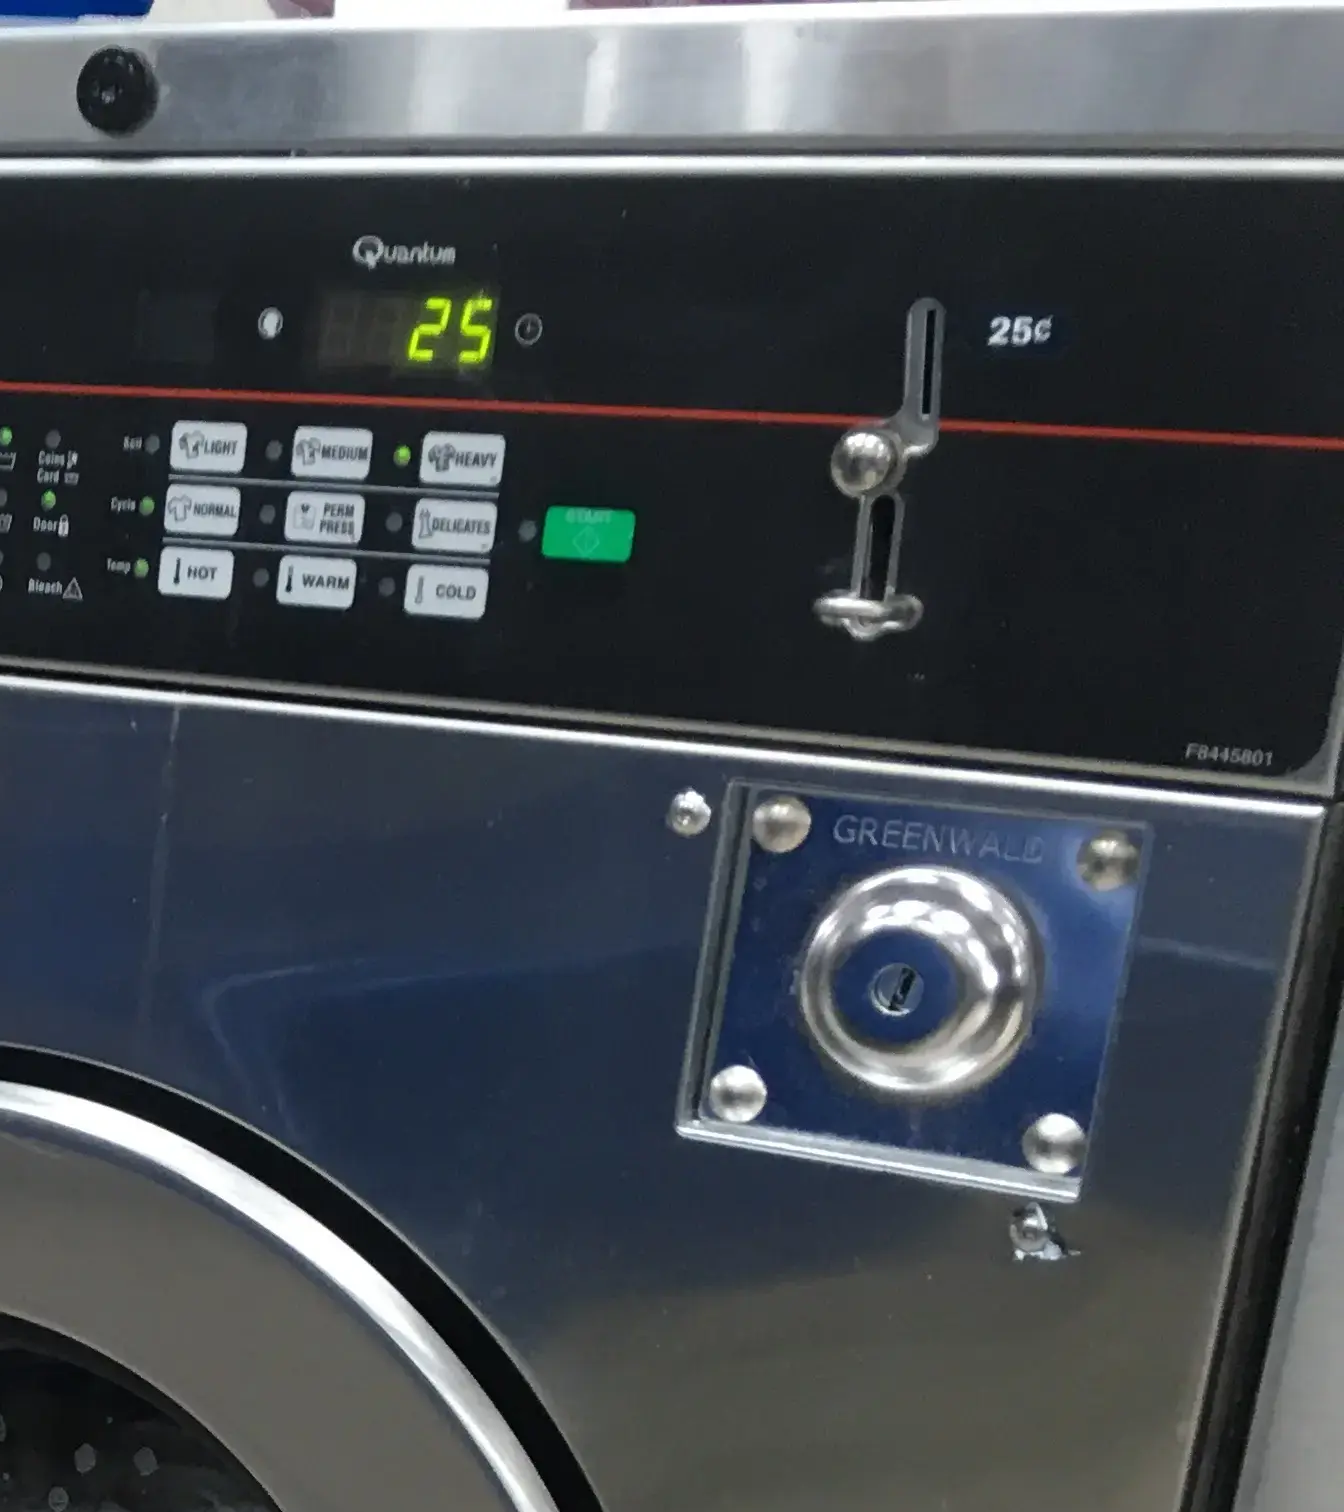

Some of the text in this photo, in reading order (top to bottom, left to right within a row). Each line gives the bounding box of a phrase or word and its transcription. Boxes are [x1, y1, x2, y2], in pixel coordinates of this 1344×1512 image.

[353, 235, 456, 270] Quantum
[408, 297, 492, 363] 25
[987, 314, 1053, 347] 25¢
[203, 440, 238, 456] LIGHT
[321, 445, 369, 461] MEDIUM
[455, 453, 497, 468] HEAVY
[37, 468, 60, 484] Card
[193, 503, 236, 518] NORMAL
[323, 502, 355, 518] PERM
[33, 516, 58, 532] Door
[319, 520, 355, 536] PRESS
[432, 517, 491, 535] DELICATES
[187, 565, 218, 581] HOT
[302, 573, 350, 590] WARM
[436, 584, 477, 601] COLD
[833, 814, 1042, 863] GREENWALD
